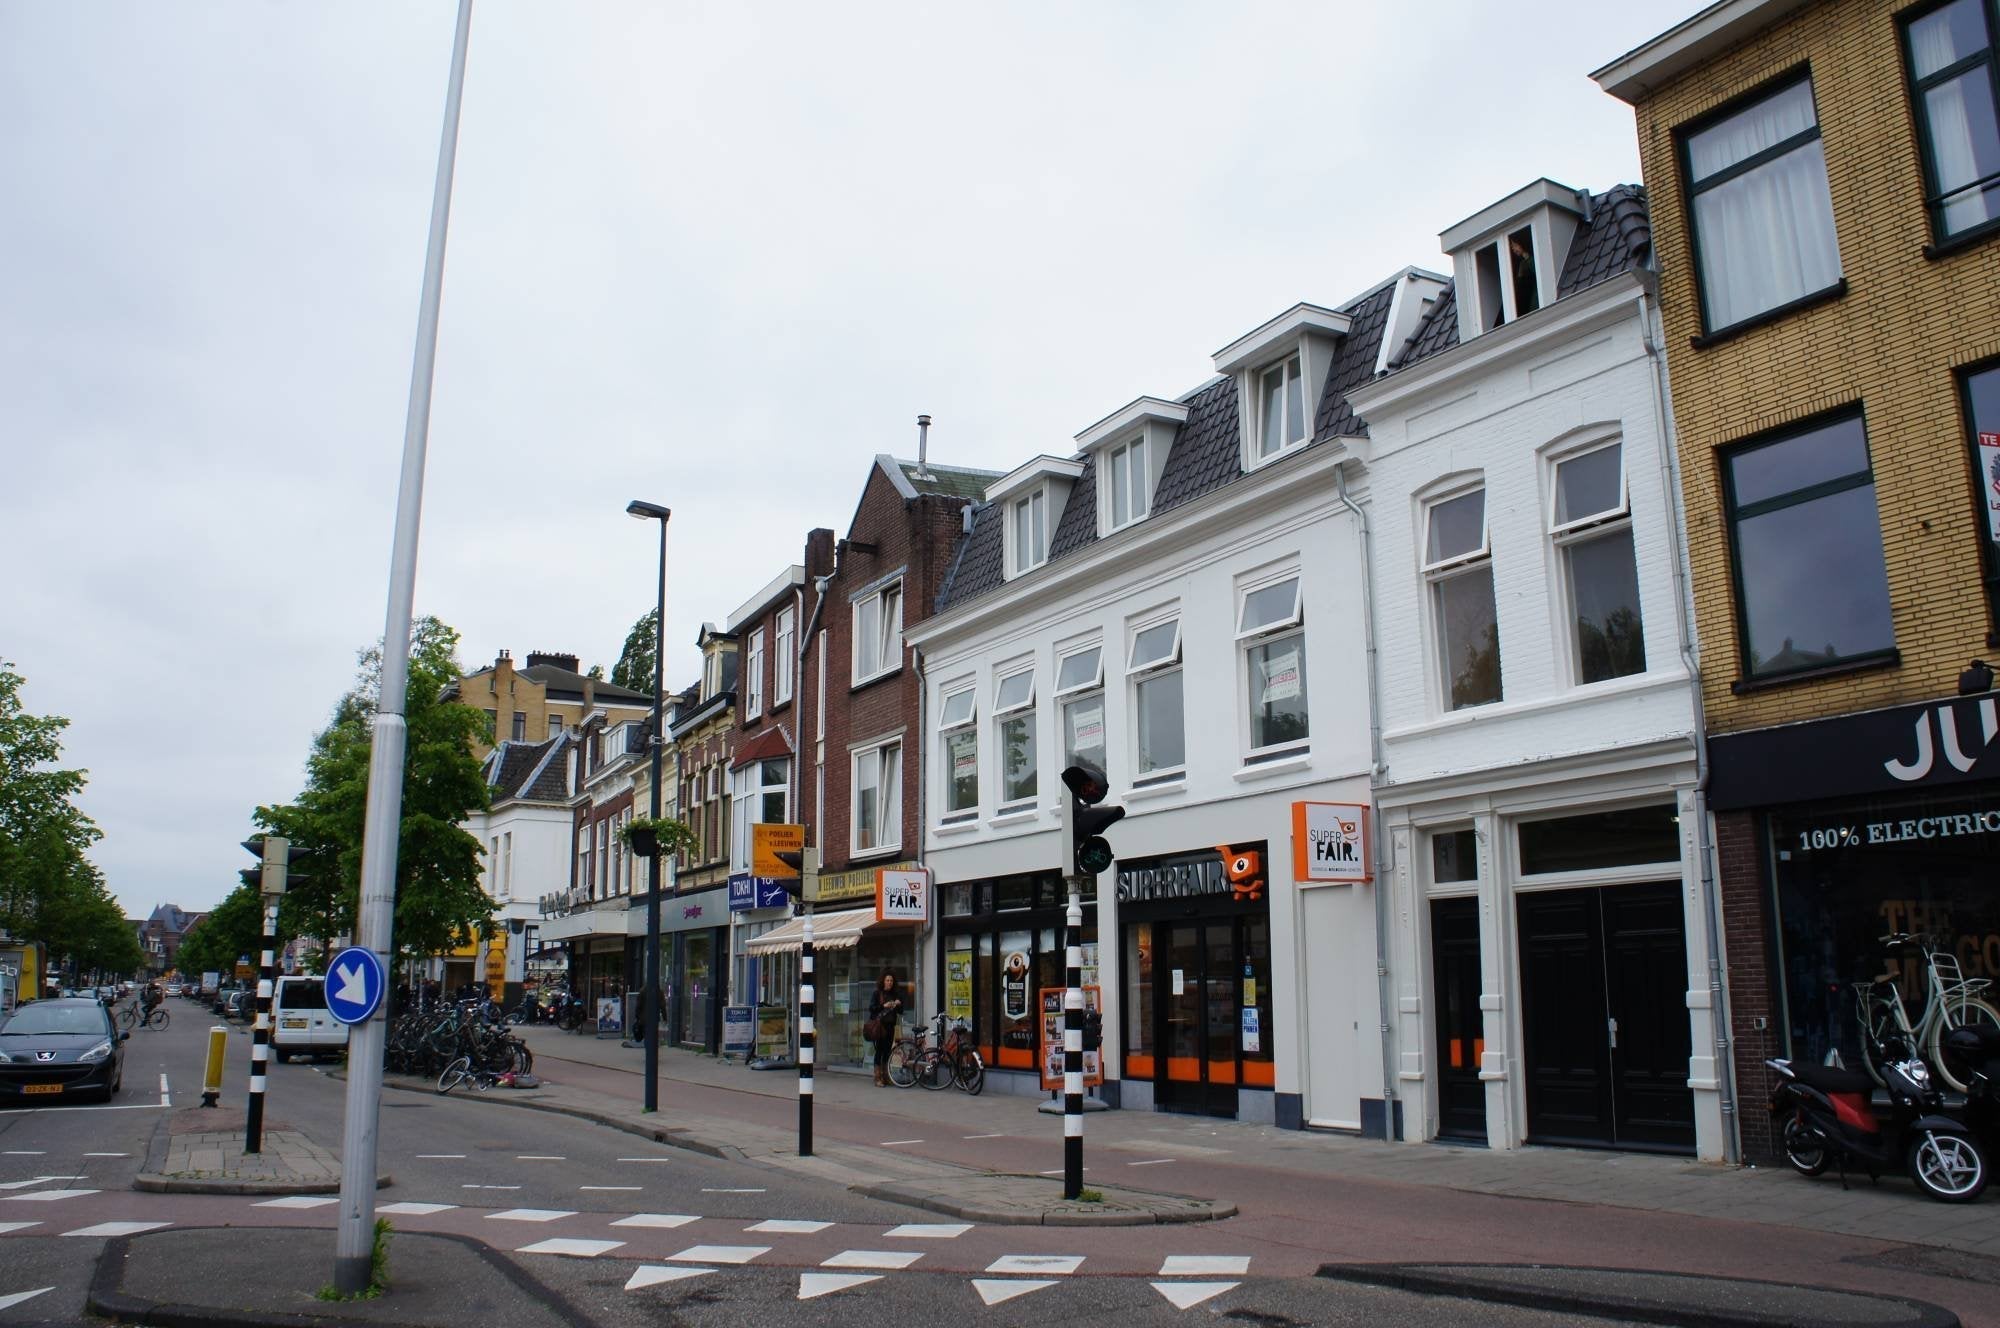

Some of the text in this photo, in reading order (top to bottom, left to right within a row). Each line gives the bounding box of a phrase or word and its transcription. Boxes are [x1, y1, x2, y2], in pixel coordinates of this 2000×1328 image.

[1310, 829, 1342, 844] SUPER
[1800, 810, 2000, 850] 100% ELECTRIC
[1316, 841, 1359, 861] FAIR.
[732, 880, 751, 896] TOKHI
[885, 886, 910, 896] SUPER
[889, 894, 921, 909] FAIR.
